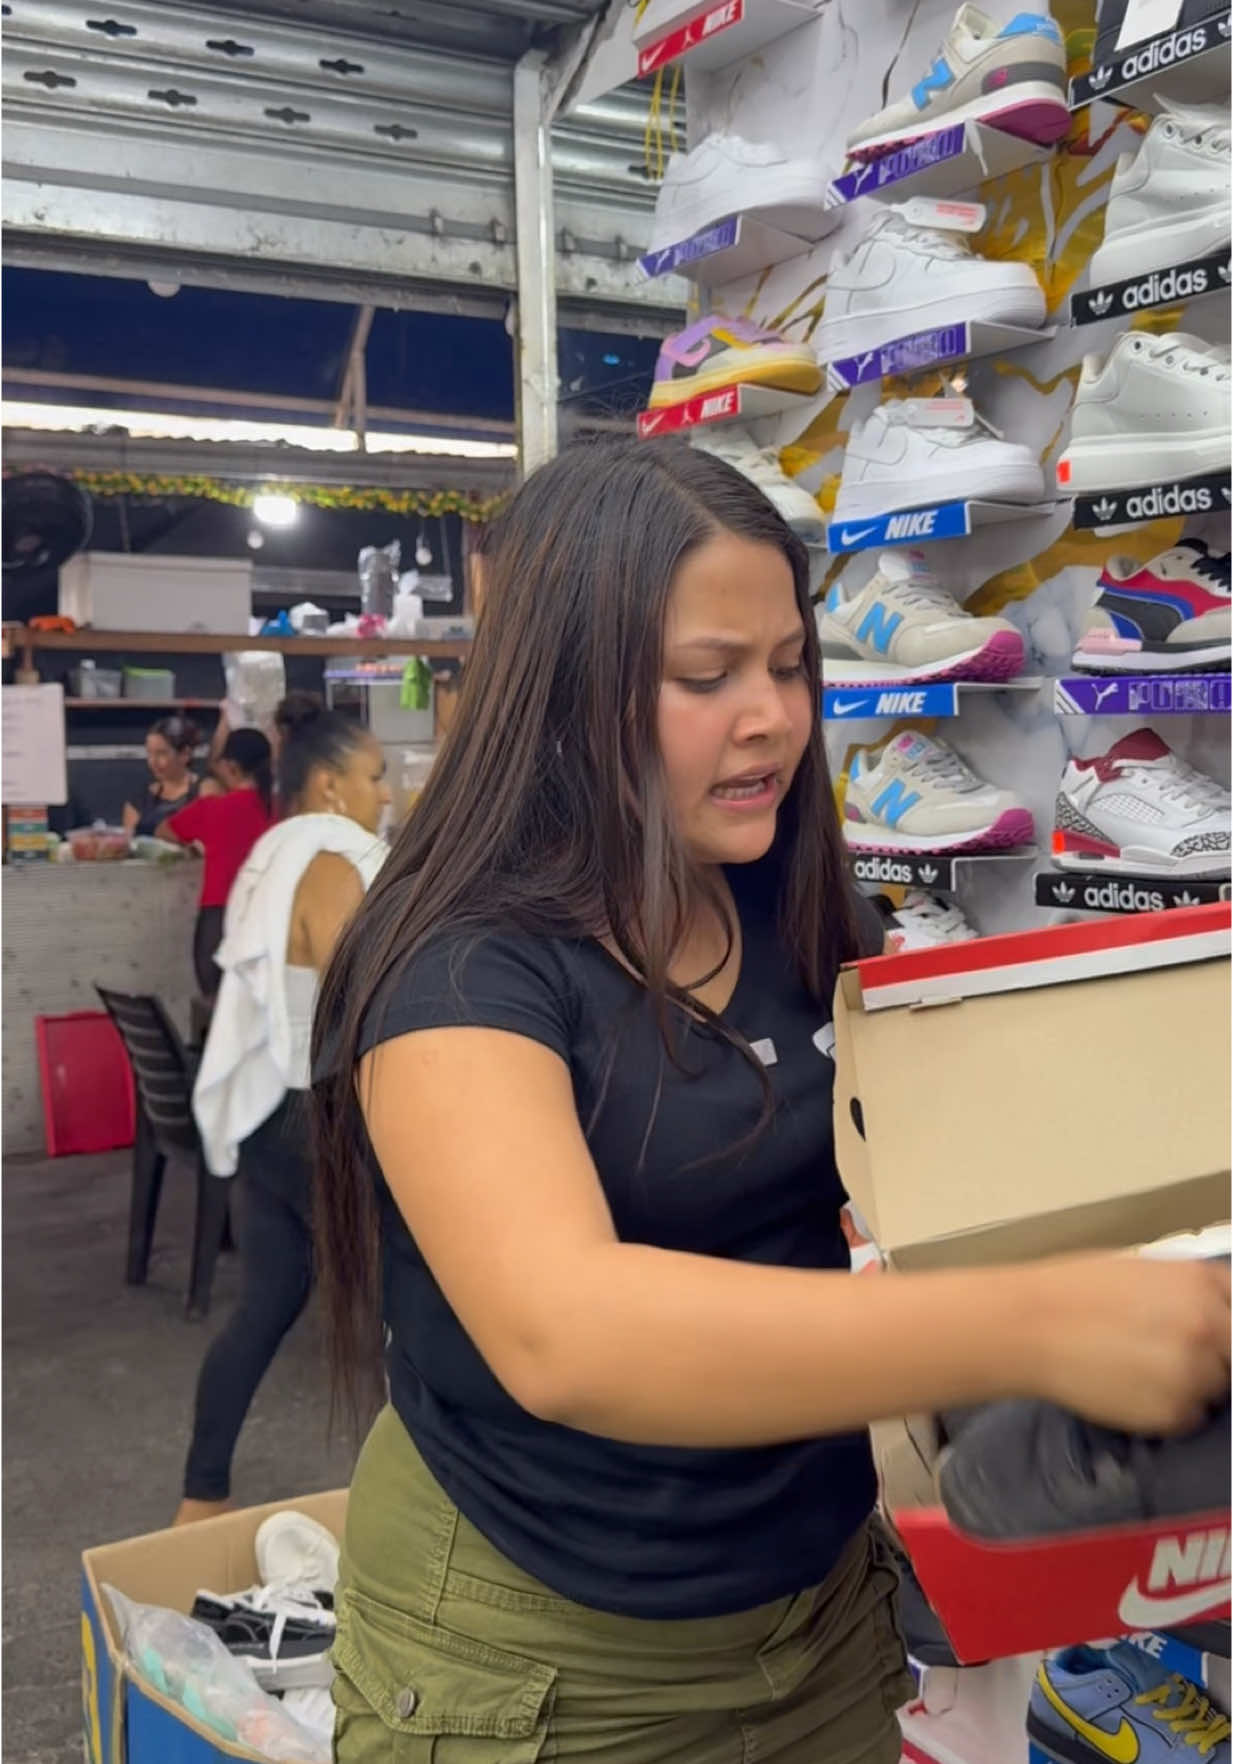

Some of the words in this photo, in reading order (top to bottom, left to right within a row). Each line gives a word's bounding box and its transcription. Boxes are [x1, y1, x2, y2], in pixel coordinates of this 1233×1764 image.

[1121, 27, 1206, 79] adidas
[1122, 268, 1208, 309] adidas
[700, 391, 735, 418] NIKE
[1126, 485, 1212, 518] adidas
[884, 510, 938, 540] NIKE
[857, 601, 902, 653] N
[875, 691, 927, 715] NIKE
[871, 778, 921, 830] N
[854, 857, 912, 884] adidas
[1084, 883, 1165, 912] adidas
